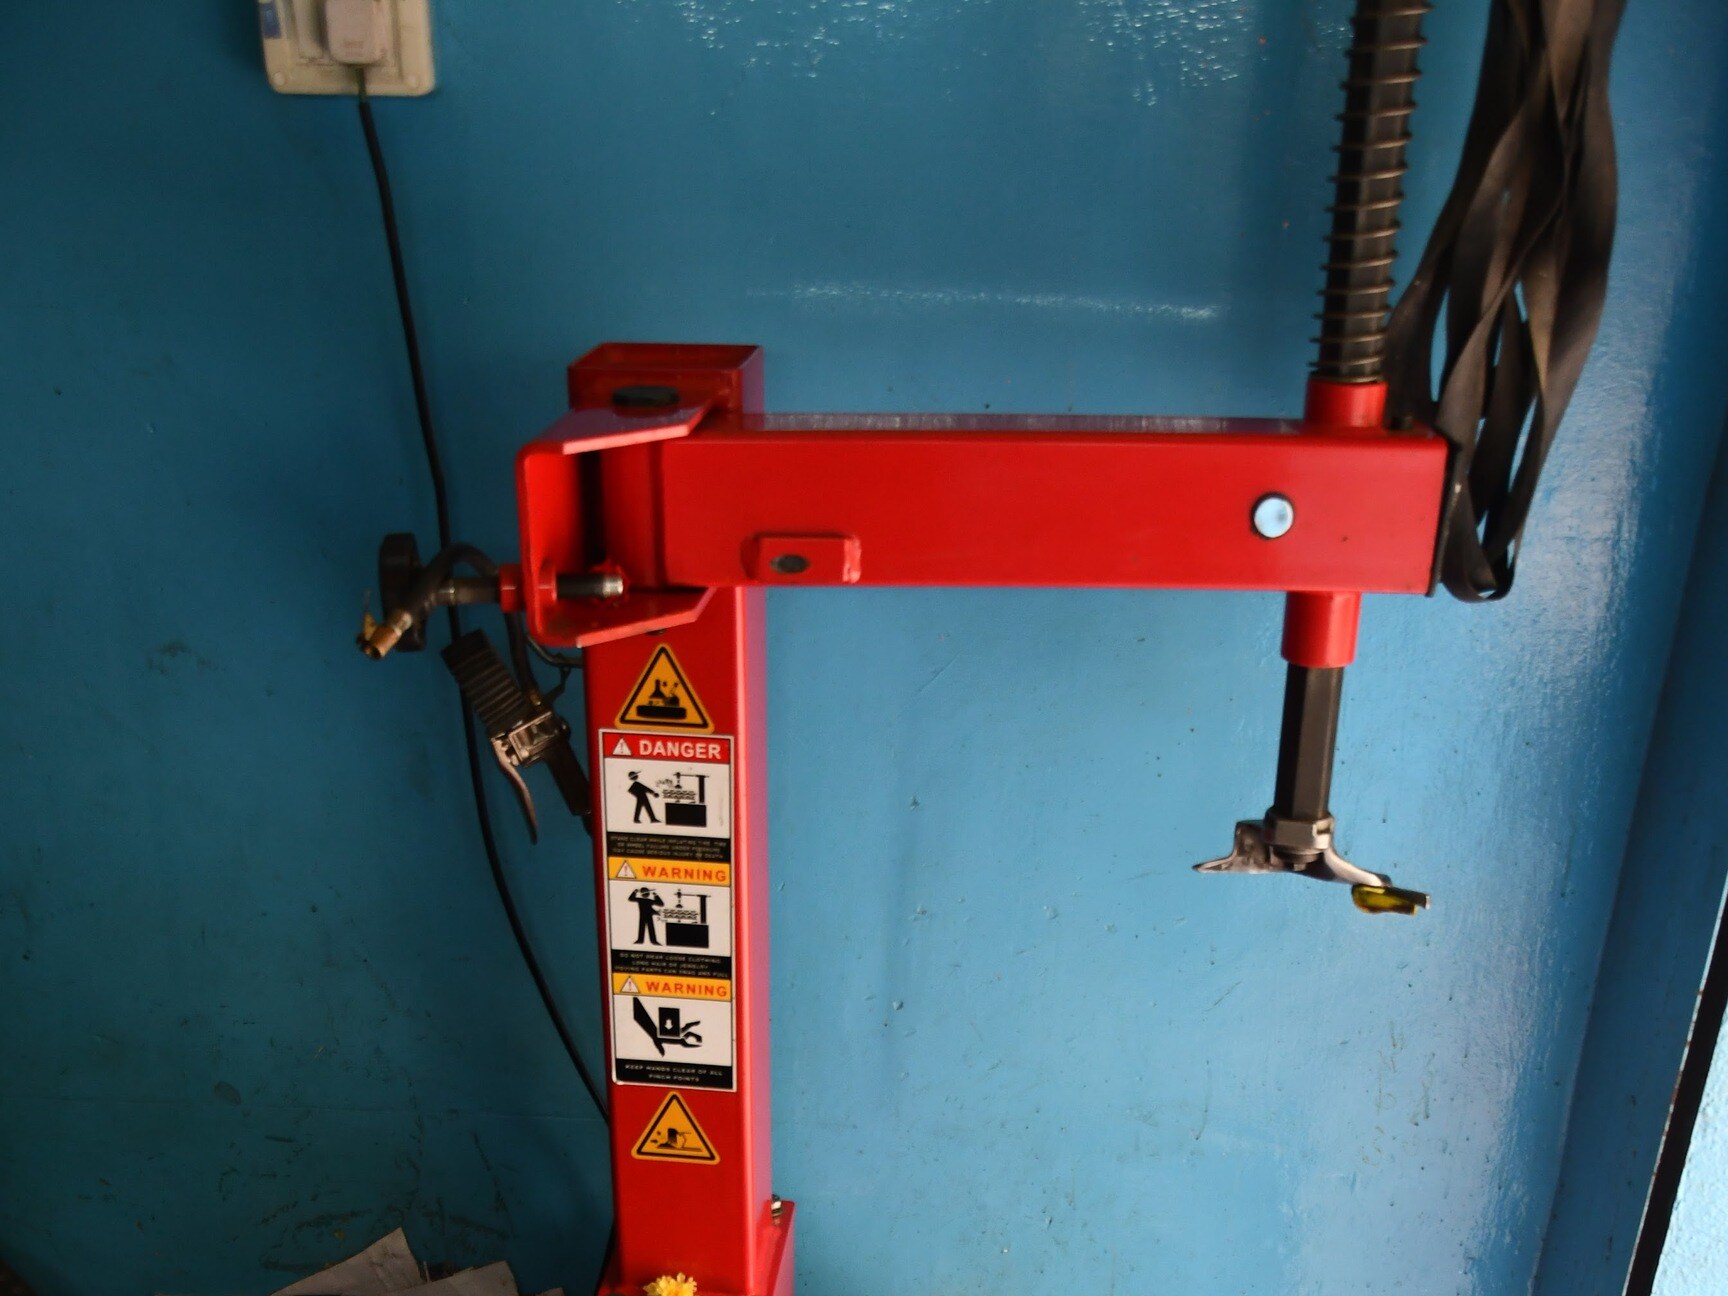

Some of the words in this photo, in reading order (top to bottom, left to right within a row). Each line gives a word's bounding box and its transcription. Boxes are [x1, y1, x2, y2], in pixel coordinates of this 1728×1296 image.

[639, 739, 722, 760] DANGER
[642, 865, 727, 883] WARNING
[645, 980, 727, 998] WARNING
[646, 1065, 671, 1073] HANDS
[673, 1067, 696, 1075] CLEAR
